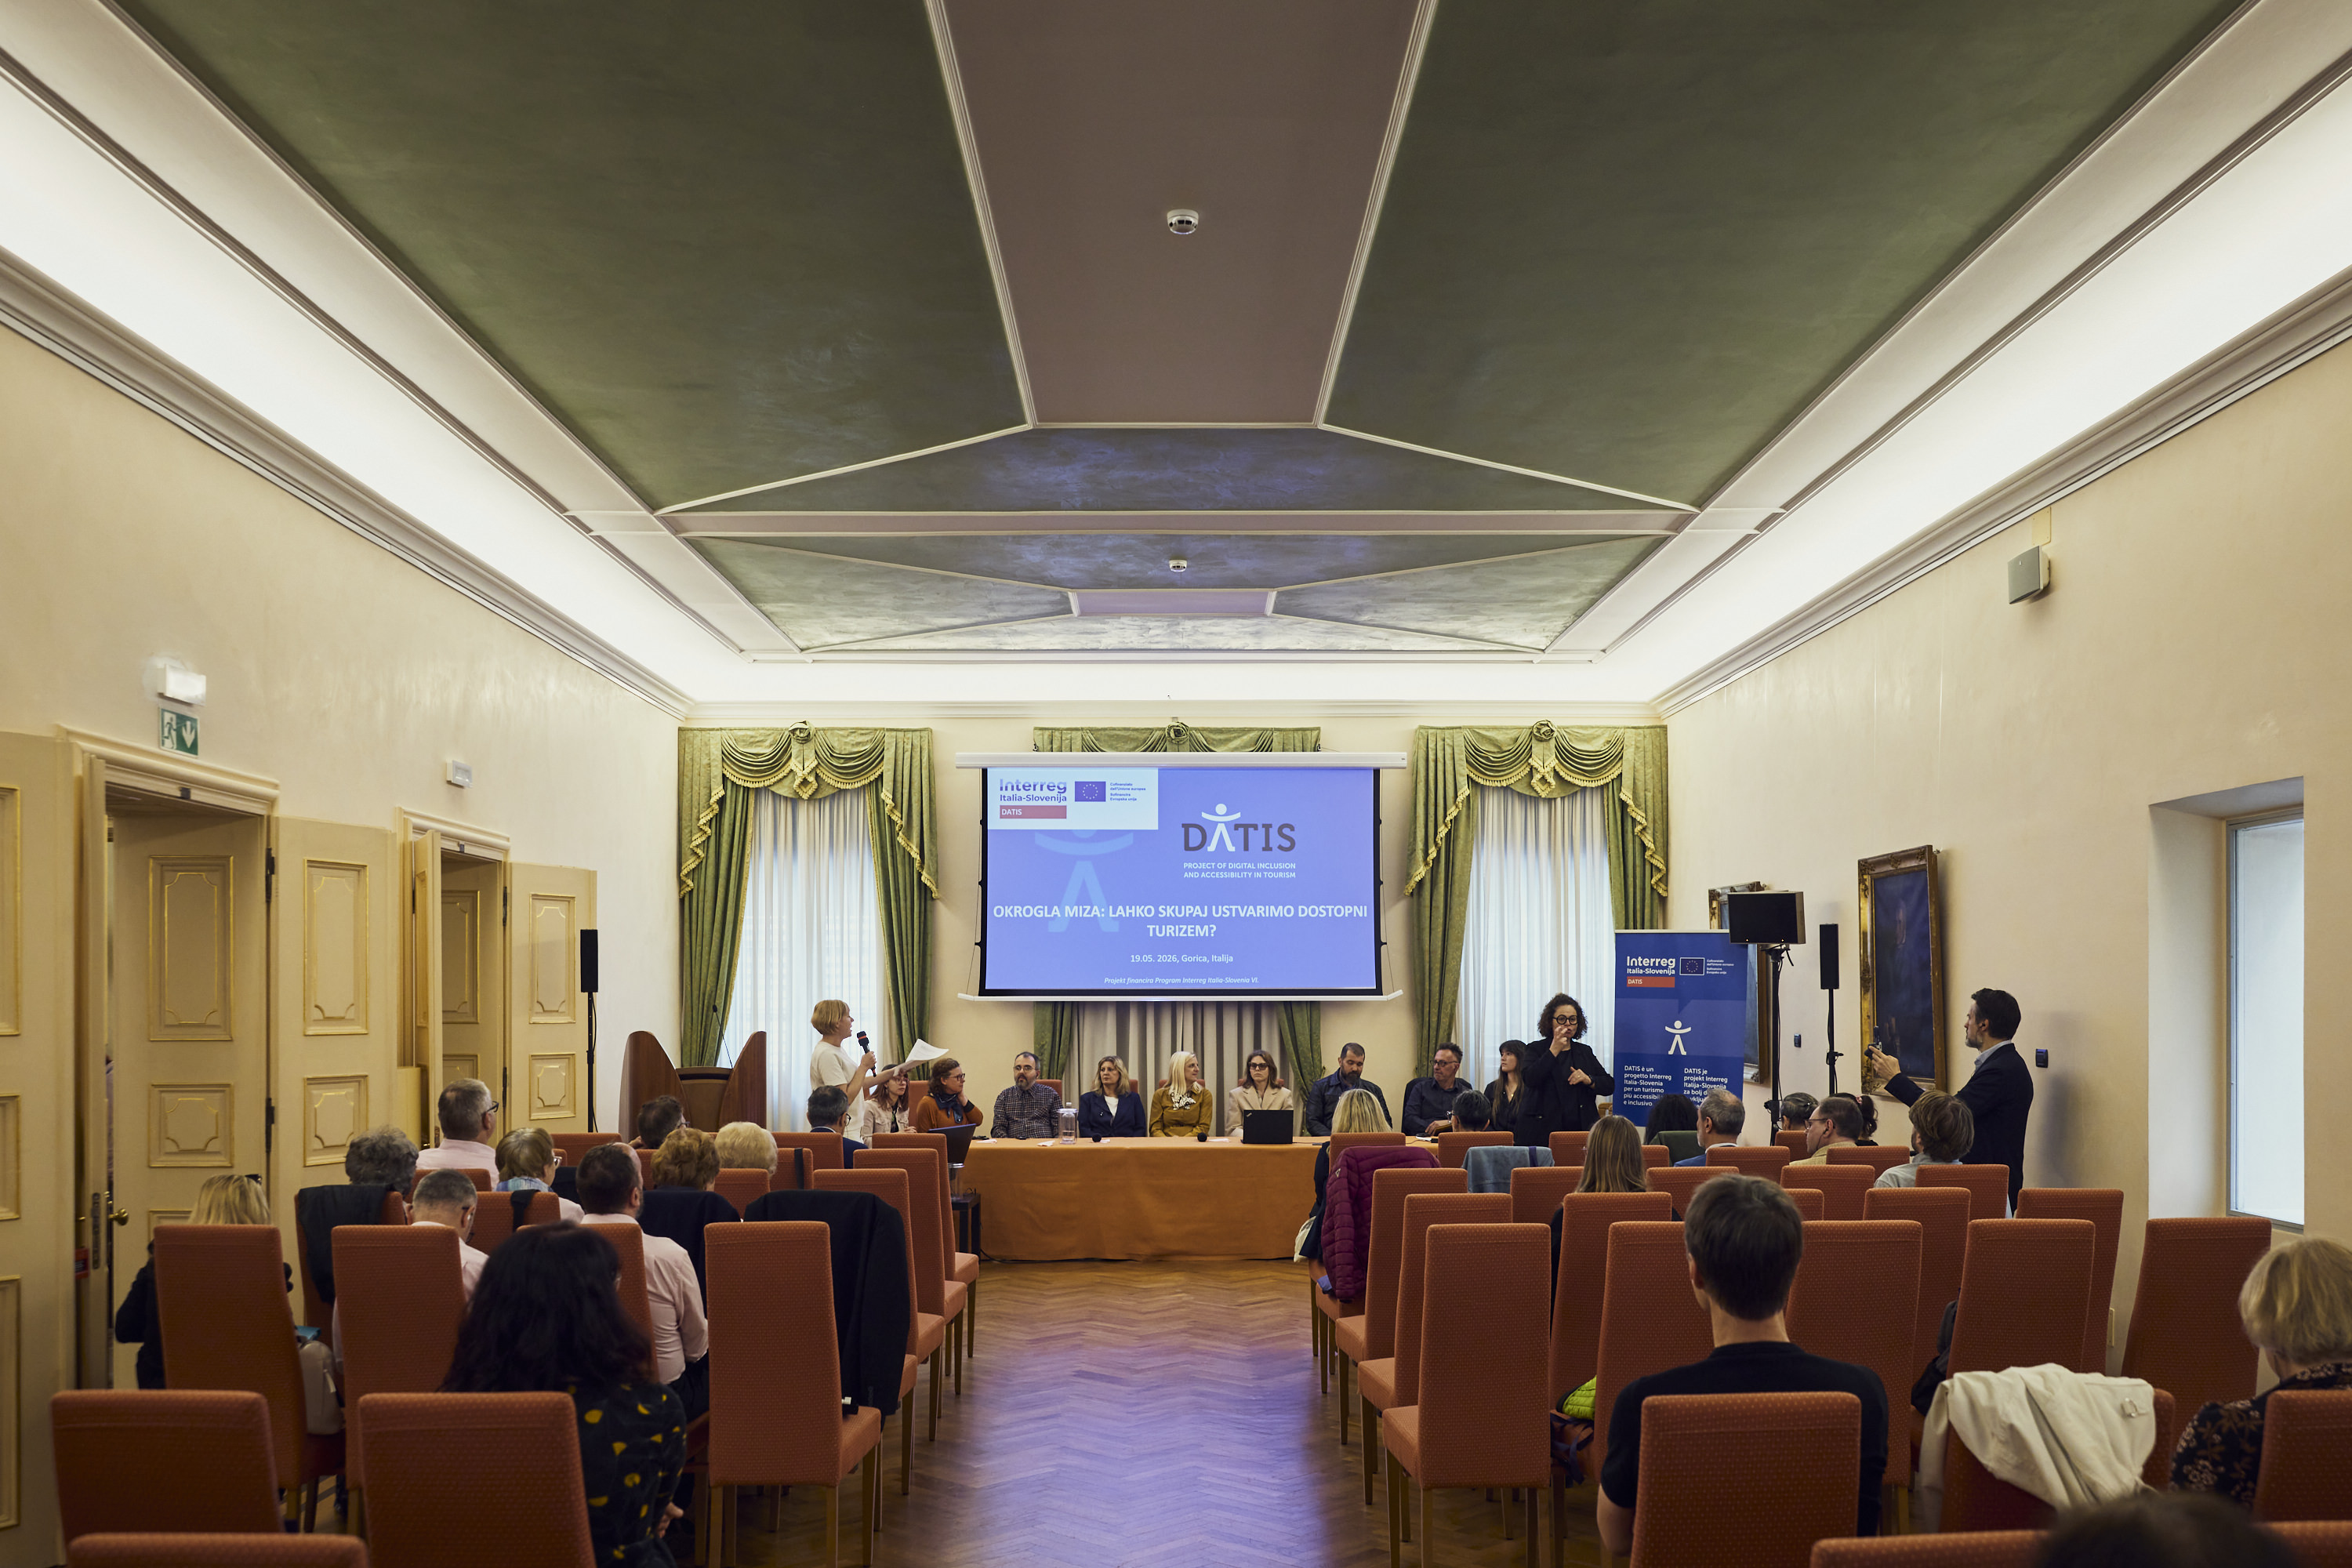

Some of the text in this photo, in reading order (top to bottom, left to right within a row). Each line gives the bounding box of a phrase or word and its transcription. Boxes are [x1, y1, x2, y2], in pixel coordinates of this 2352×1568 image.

[1000, 779, 1067, 794] Interreg
[1000, 793, 1067, 804] Italia-Slovenija
[1181, 822, 1296, 852] DATIS
[993, 905, 1367, 918] OKROGLA MIZA: LAHKO SKUPAJ USTVARIMO DOSTOPNI
[1147, 924, 1217, 938] TURIZEM?
[1131, 954, 1234, 964] 19.05. 2026, Gorica, Italija
[1627, 956, 1675, 969] Interreg
[1627, 967, 1675, 976] Italia-Slovenija
[1105, 977, 1126, 985] Projekt
[1126, 977, 1154, 985] financira
[1155, 977, 1181, 985] Program
[1182, 977, 1207, 985] Interreg
